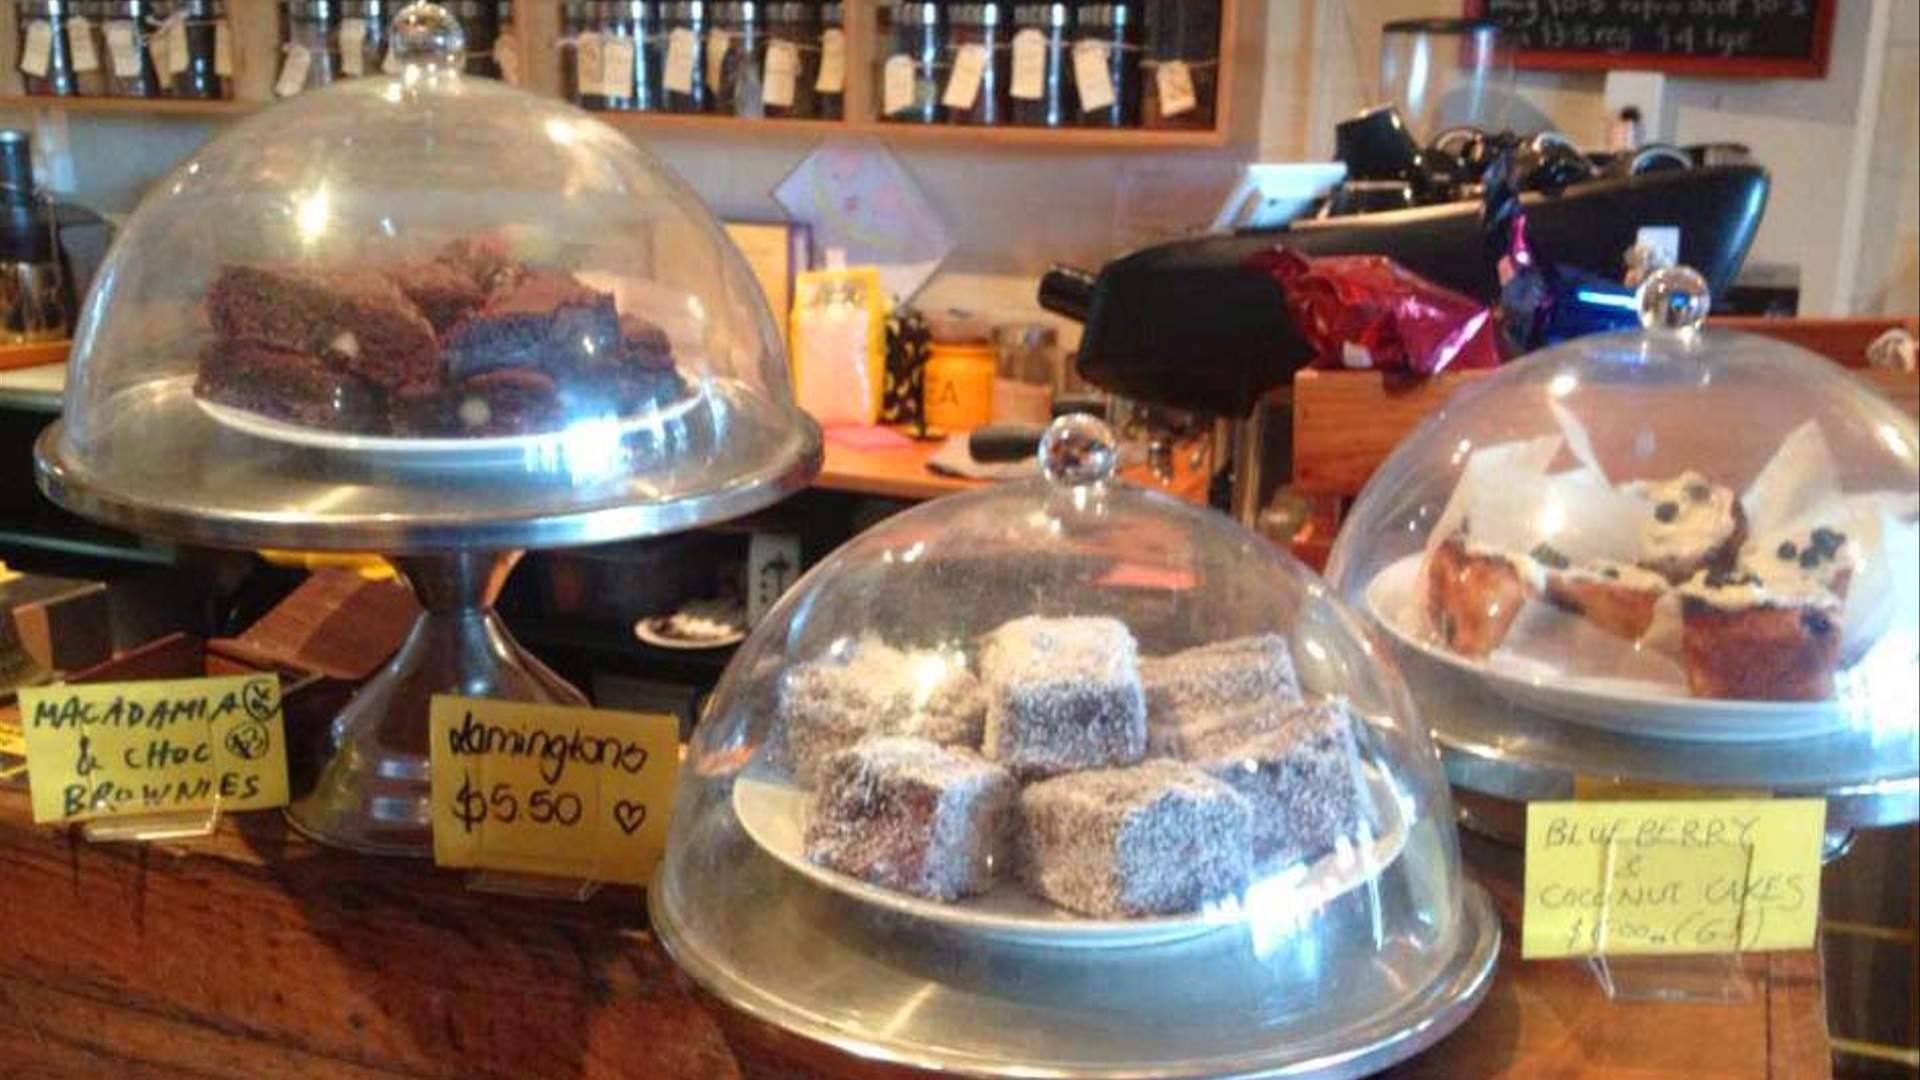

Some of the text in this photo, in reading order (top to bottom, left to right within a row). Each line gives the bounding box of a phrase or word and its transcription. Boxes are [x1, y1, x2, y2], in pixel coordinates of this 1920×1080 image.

[34, 692, 239, 730] MACADAMIA
[76, 736, 211, 776] & CHOC
[63, 772, 262, 816] BROWNIES
